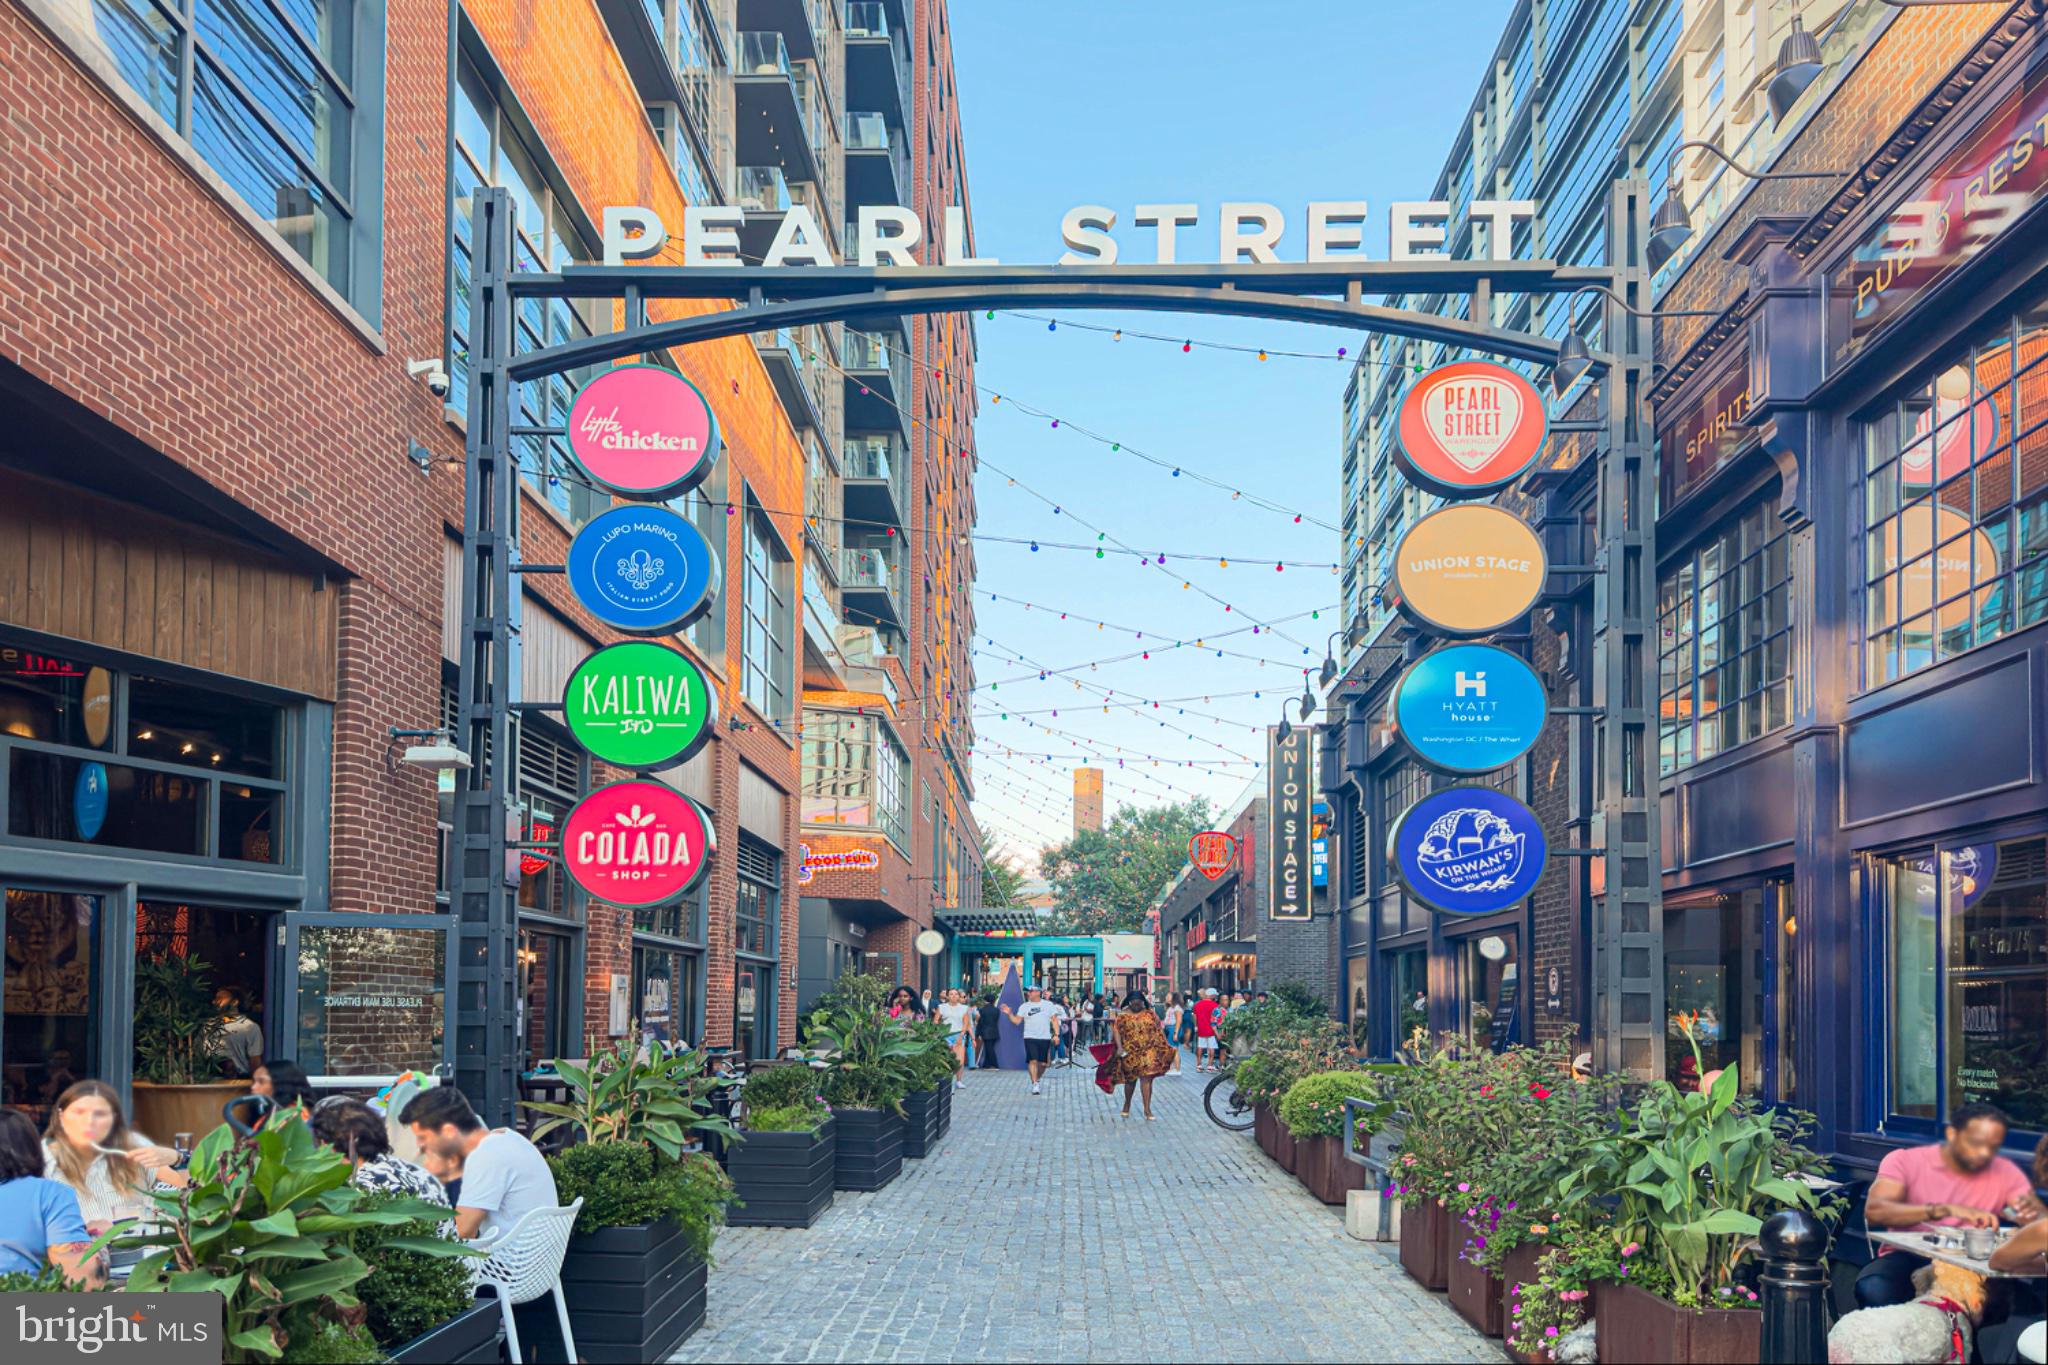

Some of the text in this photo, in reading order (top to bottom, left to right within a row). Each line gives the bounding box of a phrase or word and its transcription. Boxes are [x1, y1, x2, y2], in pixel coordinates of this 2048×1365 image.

[603, 200, 1535, 267] PEARL STREET
[1855, 239, 1915, 311] PUB
[1444, 387, 1502, 411] PEARL
[1444, 413, 1501, 436] STREET
[602, 430, 697, 451] chicken
[602, 522, 678, 543] LUPO MARINO
[1410, 556, 1532, 573] UNION STAGE
[582, 674, 691, 716] KALIWA
[1442, 701, 1498, 711] HYATT
[1451, 713, 1491, 722] house
[1283, 731, 1298, 900] UNION STAGE
[577, 831, 690, 866] COLADA
[805, 855, 871, 866] FOOD FUN
[1435, 849, 1514, 879] KIRWAN'S
[612, 870, 650, 880] SHOP
[1451, 864, 1507, 884] ON THE WHARF
